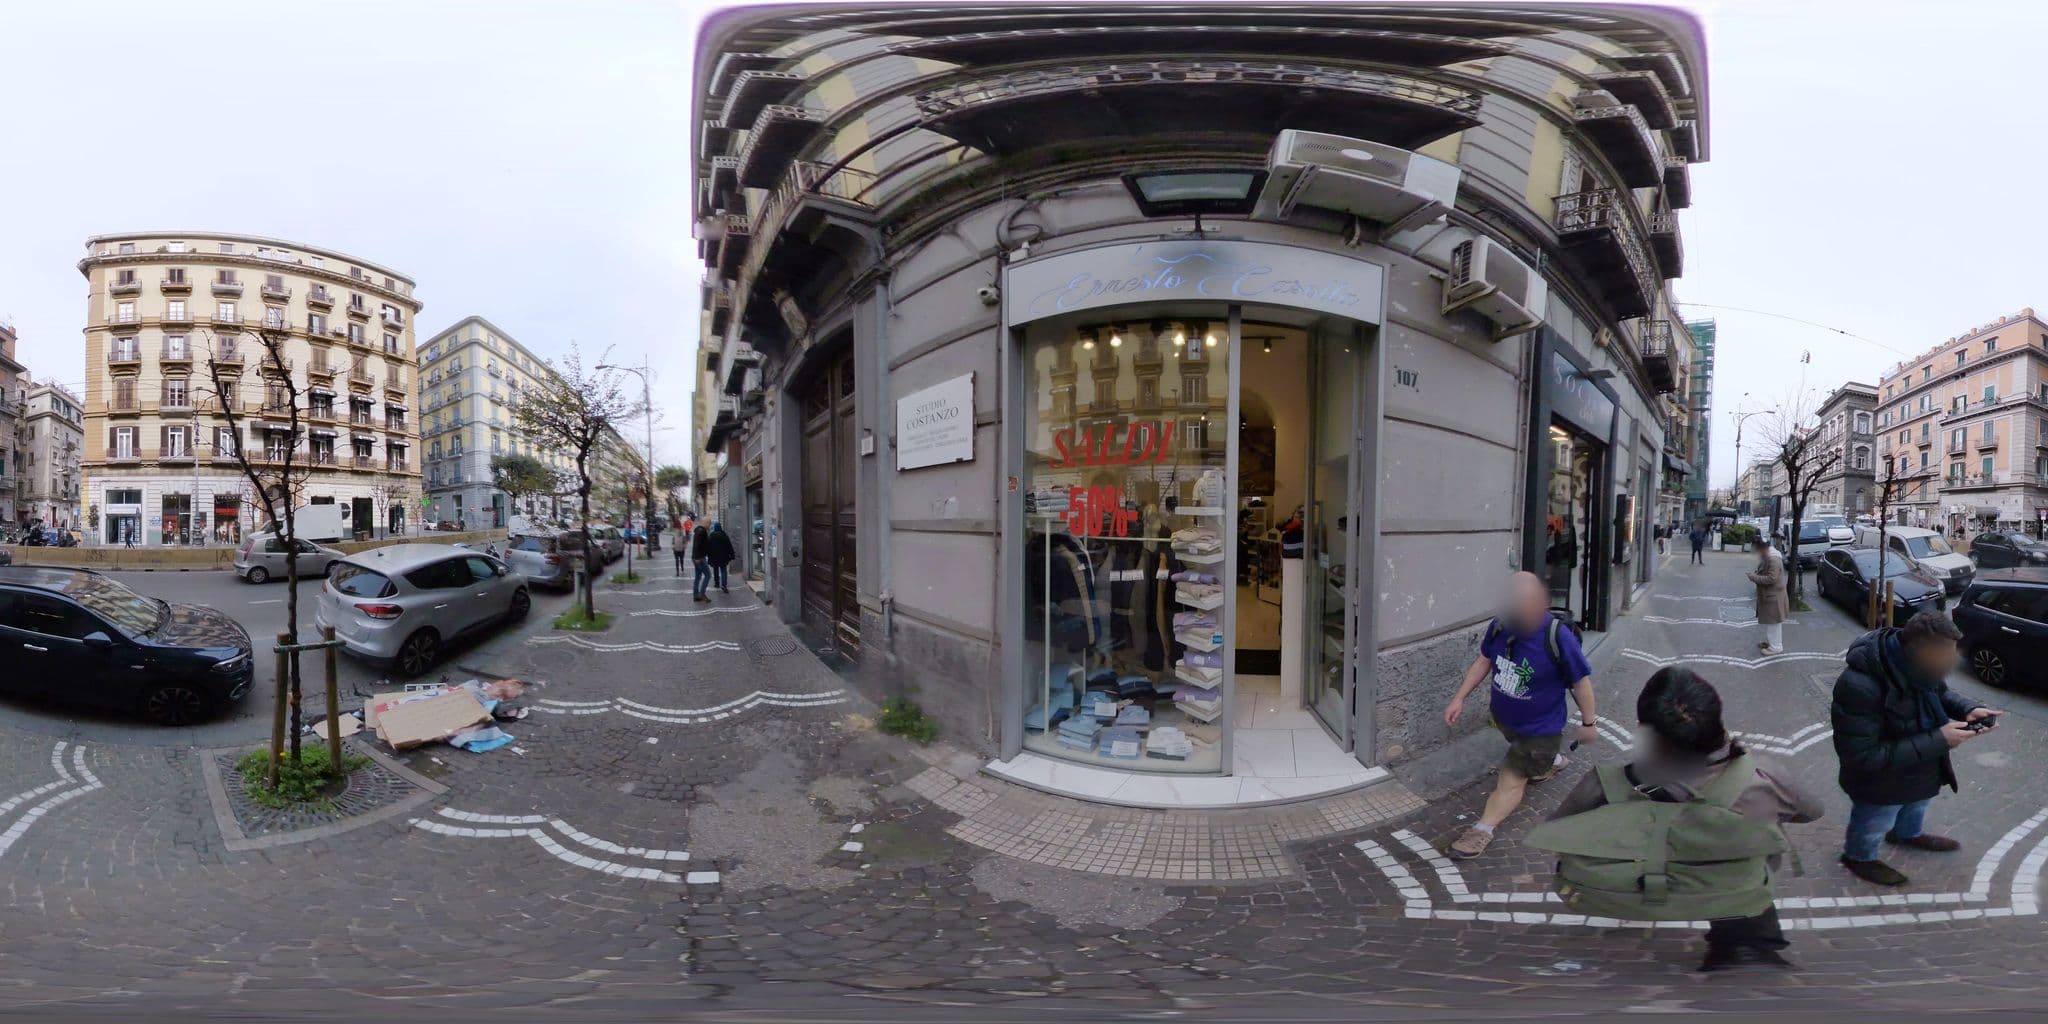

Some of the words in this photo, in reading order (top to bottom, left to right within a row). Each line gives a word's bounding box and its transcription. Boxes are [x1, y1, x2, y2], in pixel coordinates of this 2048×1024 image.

[1029, 256, 1196, 313] Ernesto
[1397, 370, 1418, 388] 107
[906, 406, 960, 431] COSTANZO
[915, 399, 946, 415] STUDIO
[1048, 420, 1176, 469] SALDI
